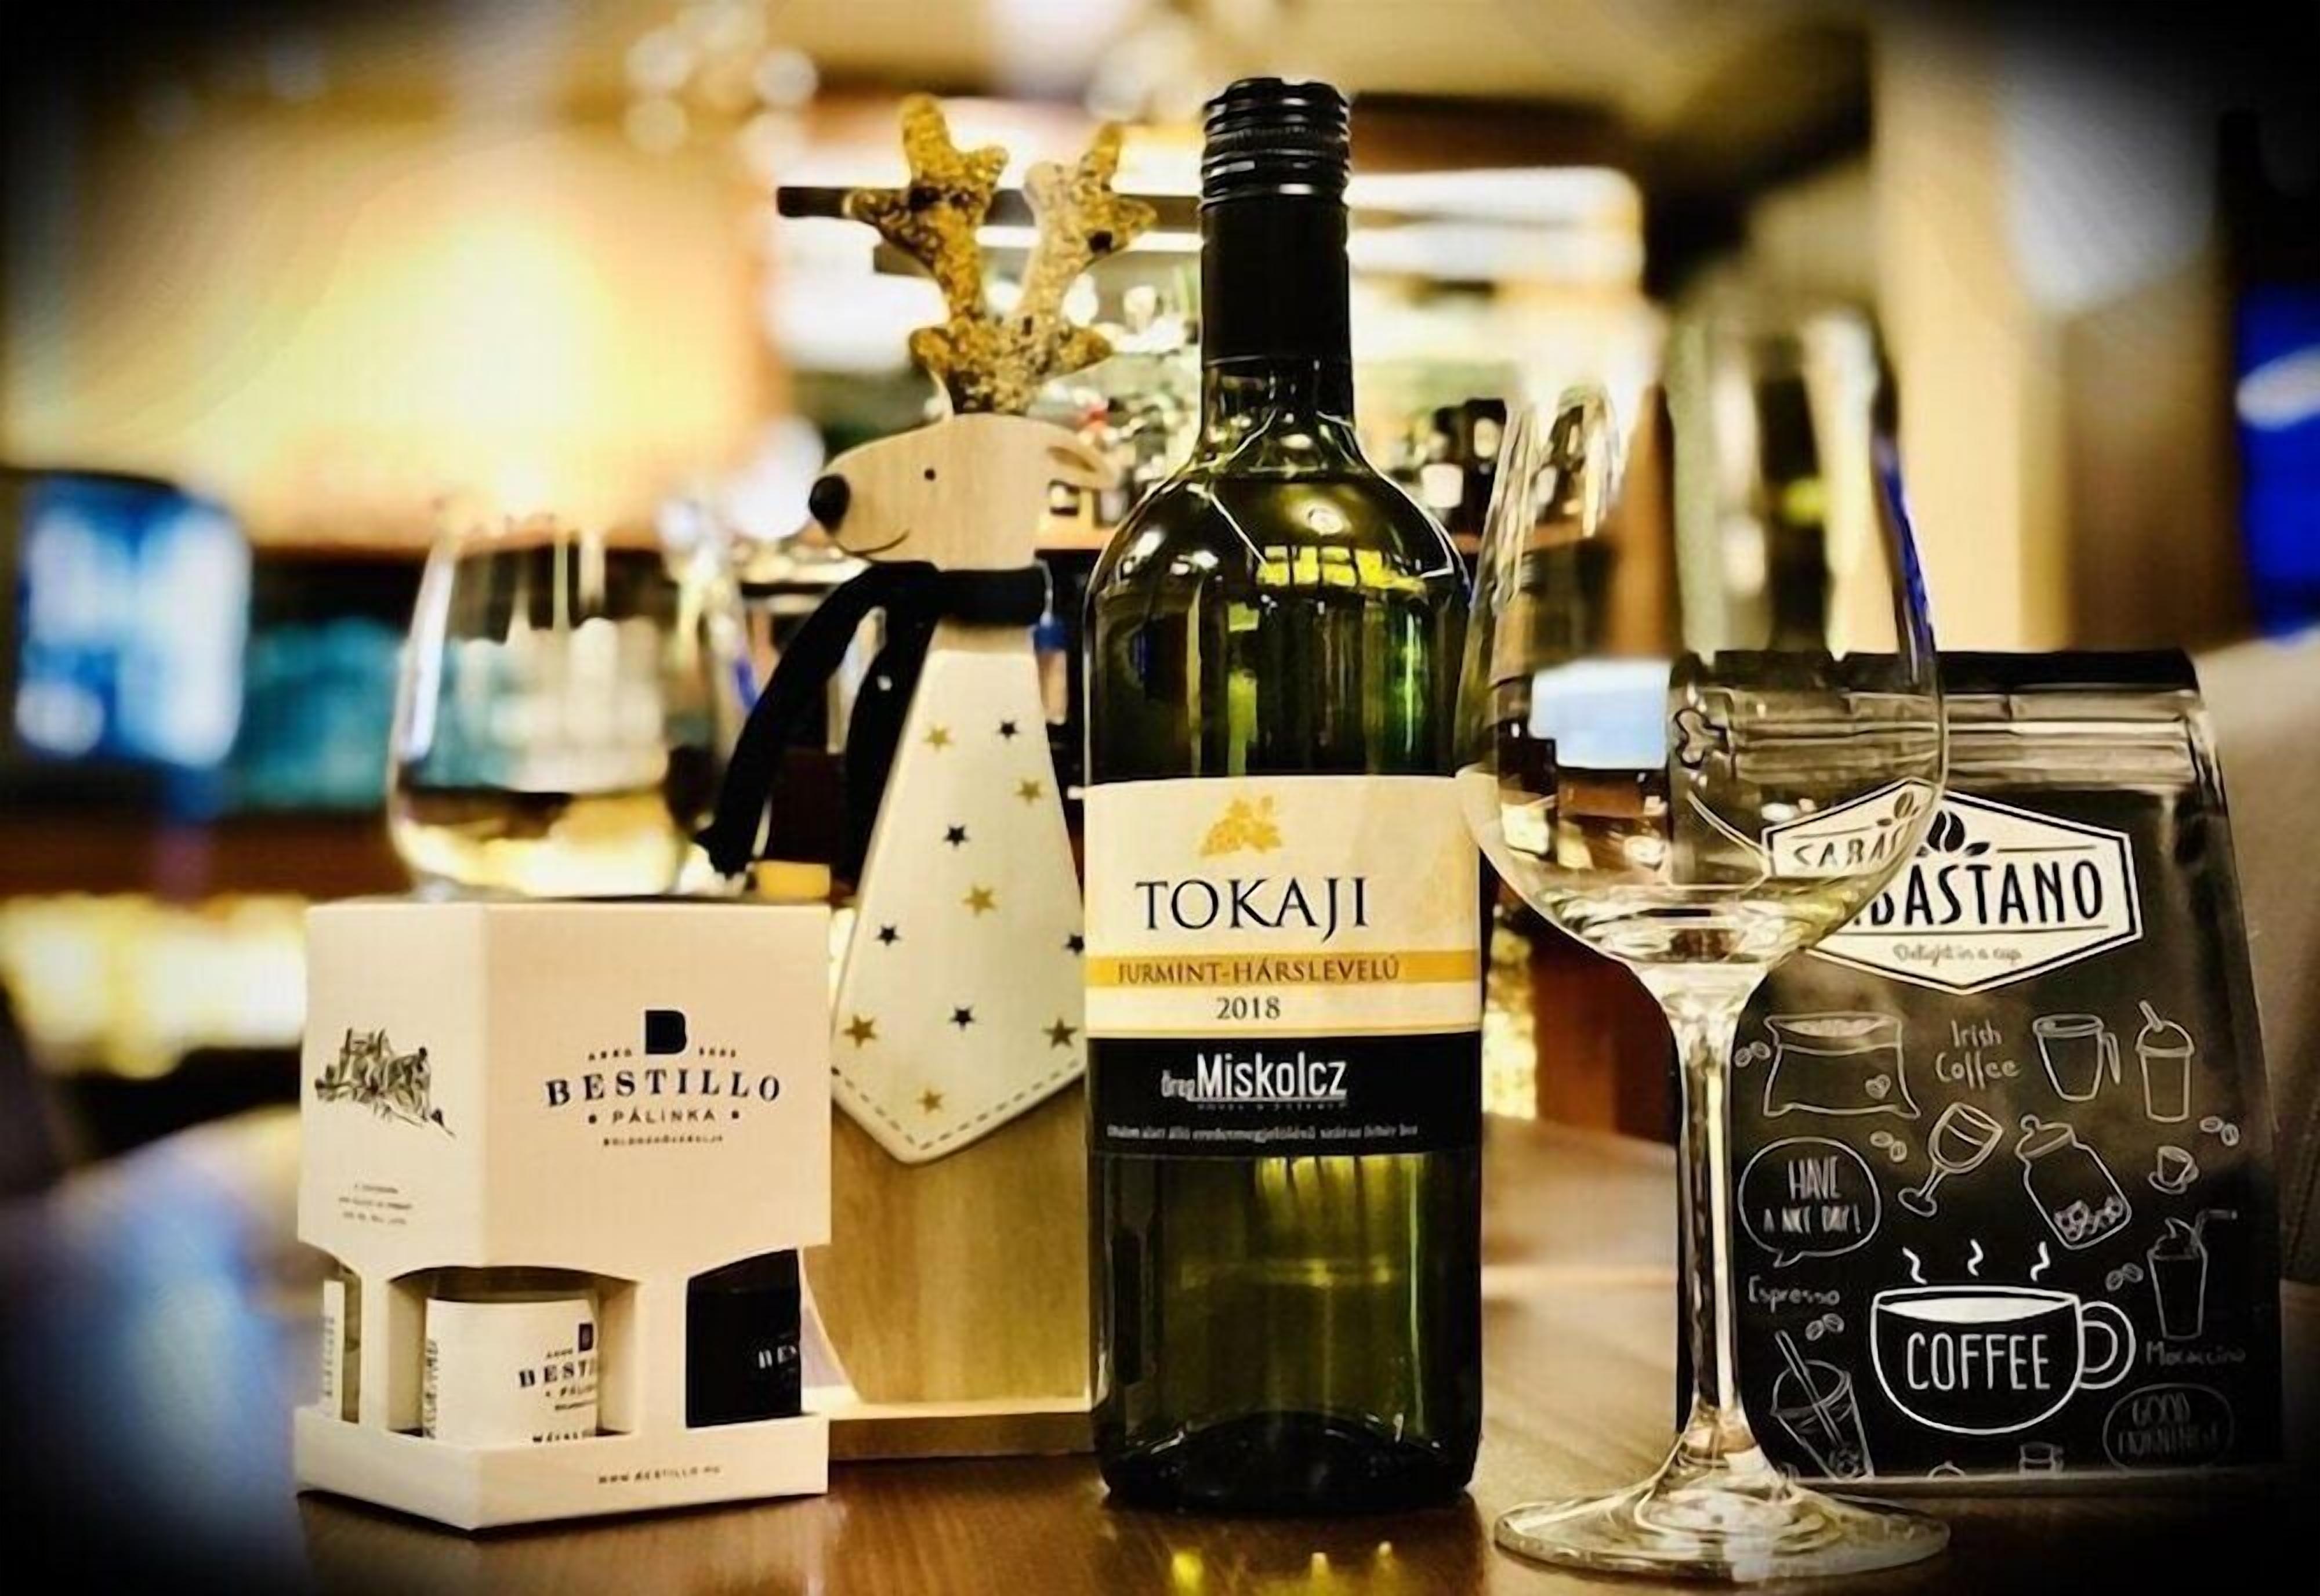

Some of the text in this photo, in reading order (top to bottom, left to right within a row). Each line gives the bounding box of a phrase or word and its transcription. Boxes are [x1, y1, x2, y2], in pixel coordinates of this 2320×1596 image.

[1134, 876, 1371, 942] TOKAJI
[1216, 995, 1281, 1020] 2018
[1951, 1019, 2002, 1049] Irish
[545, 1068, 780, 1107] BESTILLO
[1197, 1050, 1348, 1098] Miskolcz
[1935, 1052, 2022, 1090] Coffee
[612, 1108, 716, 1124] PÁLINKA
[1748, 1275, 1840, 1314] Espresso
[1906, 1332, 2050, 1391] COFFEE
